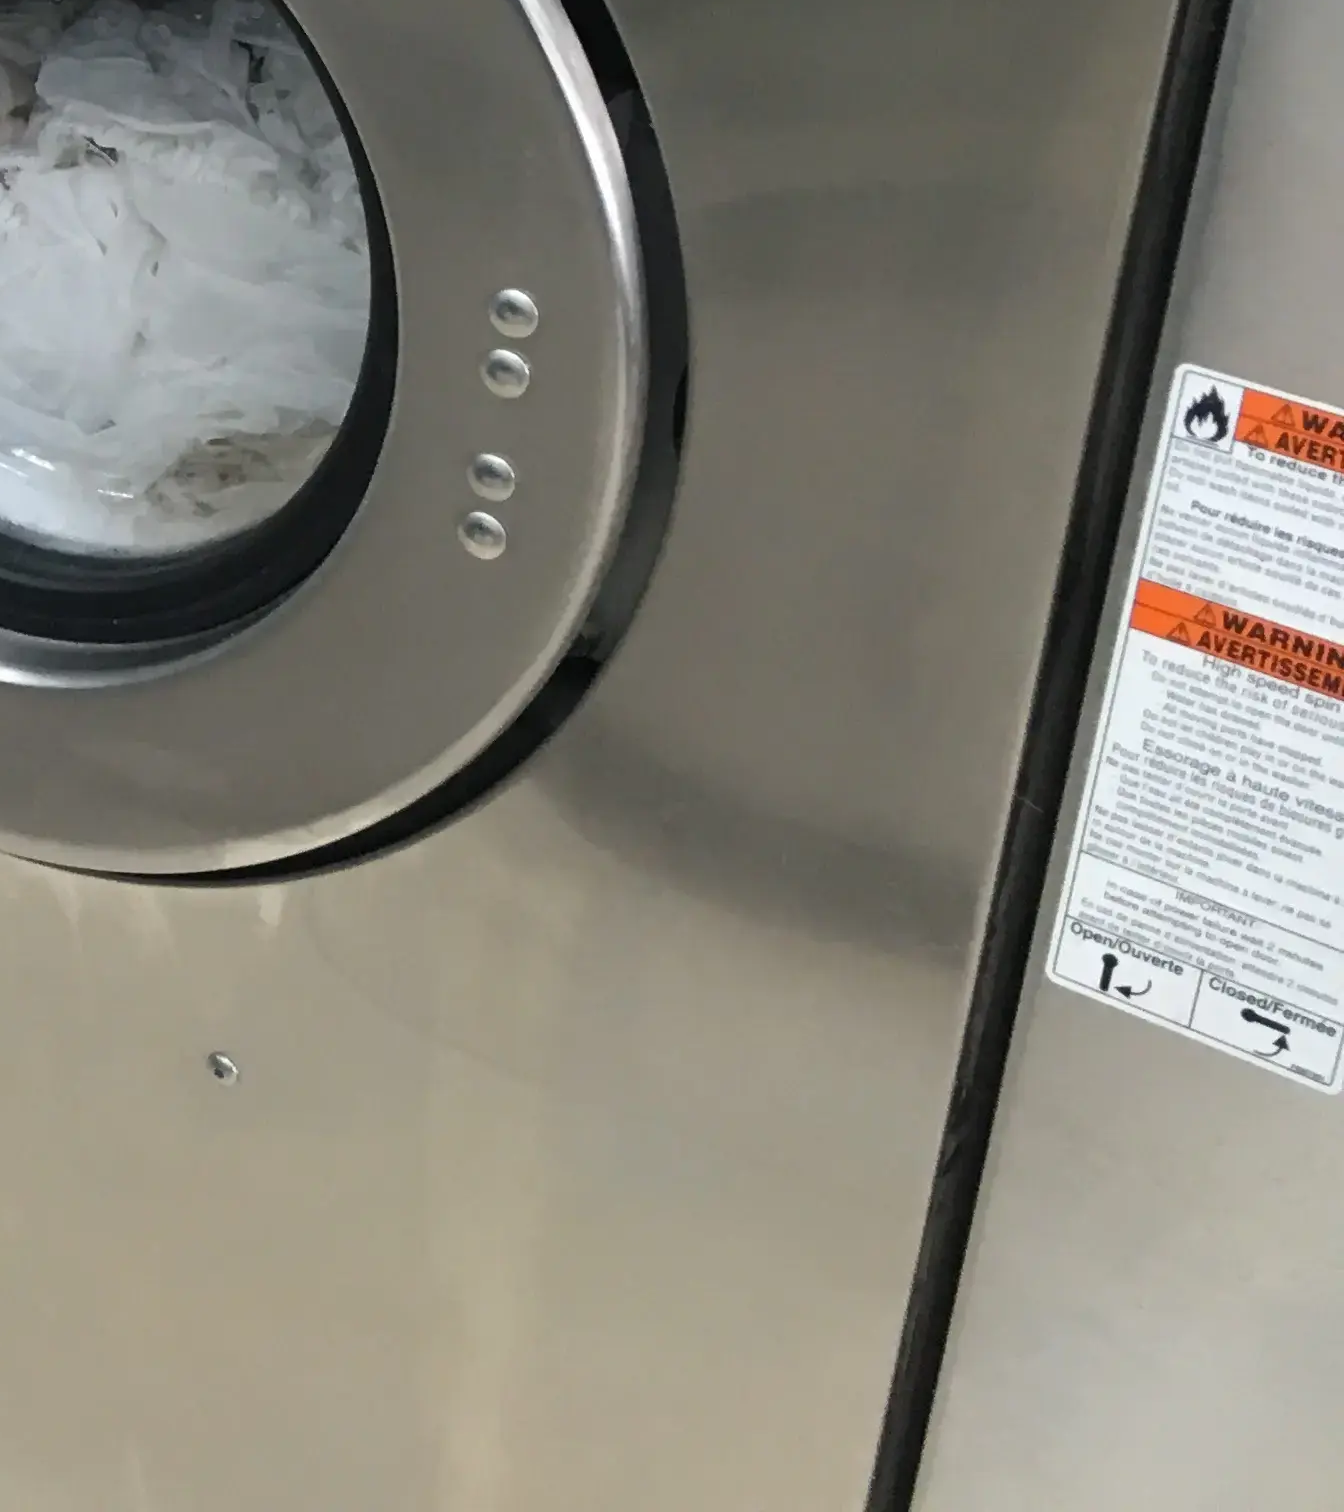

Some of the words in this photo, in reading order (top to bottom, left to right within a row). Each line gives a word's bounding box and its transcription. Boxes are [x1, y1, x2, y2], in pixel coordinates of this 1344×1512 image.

[1269, 455, 1327, 481] reduce
[1195, 630, 1344, 698] AVERTISSEM
[1222, 610, 1344, 672] WARNIN
[1202, 655, 1242, 679] High
[1247, 673, 1300, 699] speed
[1305, 693, 1341, 713] spin
[1143, 738, 1222, 777] Essorage
[1242, 775, 1290, 802] haute
[1175, 888, 1259, 929] IMPORTANT
[1070, 921, 1185, 977] Open/Ouverte
[1208, 976, 1336, 1038] Closed/Fermée
